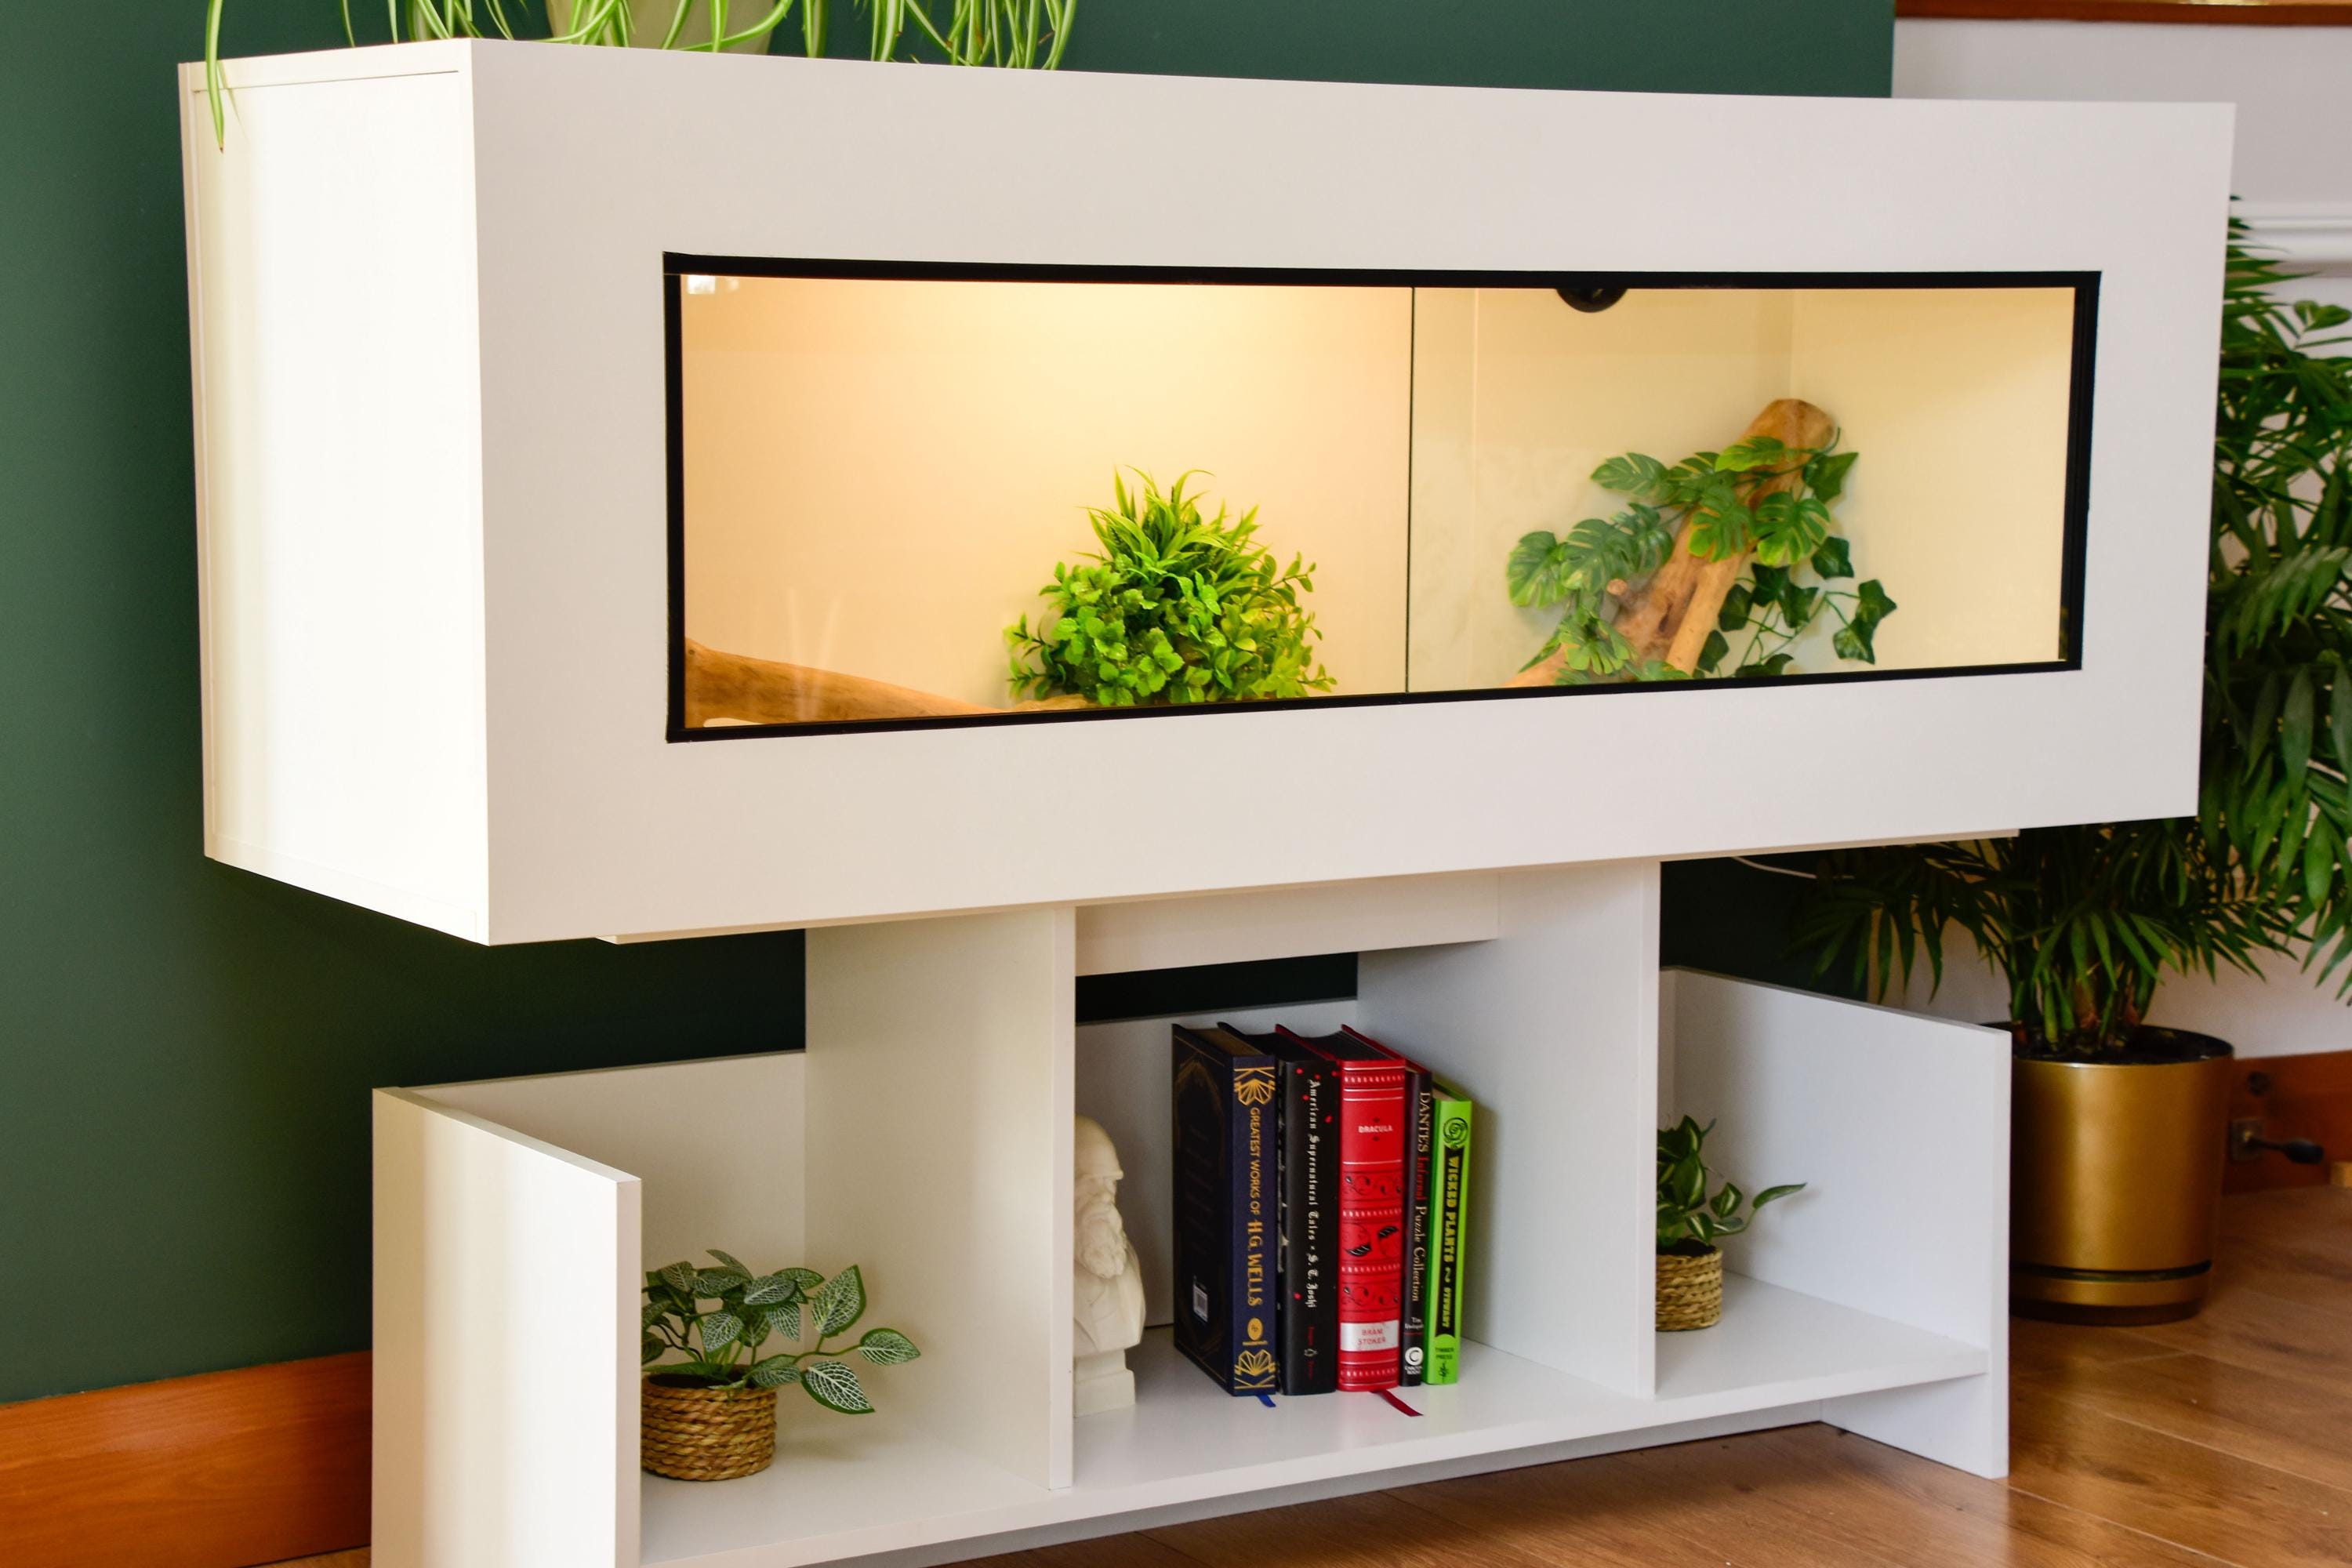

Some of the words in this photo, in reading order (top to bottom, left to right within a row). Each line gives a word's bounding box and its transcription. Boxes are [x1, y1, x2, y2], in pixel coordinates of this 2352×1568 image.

[1308, 1079, 1321, 1129] American
[1250, 1107, 1261, 1157] GREATEST
[1358, 1125, 1393, 1134] DRACULA
[1250, 1160, 1261, 1199] WORKS
[1307, 1134, 1320, 1205] Supernatural
[1416, 1156, 1430, 1201] Infernal
[1446, 1156, 1460, 1207] WICKED
[1250, 1201, 1261, 1215] OF
[1308, 1211, 1319, 1240] Tales
[1414, 1206, 1428, 1243] Puzzle
[1443, 1211, 1457, 1263] PLANTS
[1247, 1253, 1263, 1306] WELLS
[1305, 1283, 1319, 1308] Joshi
[1411, 1247, 1426, 1301] Collection
[1357, 1337, 1387, 1345] STOKER
